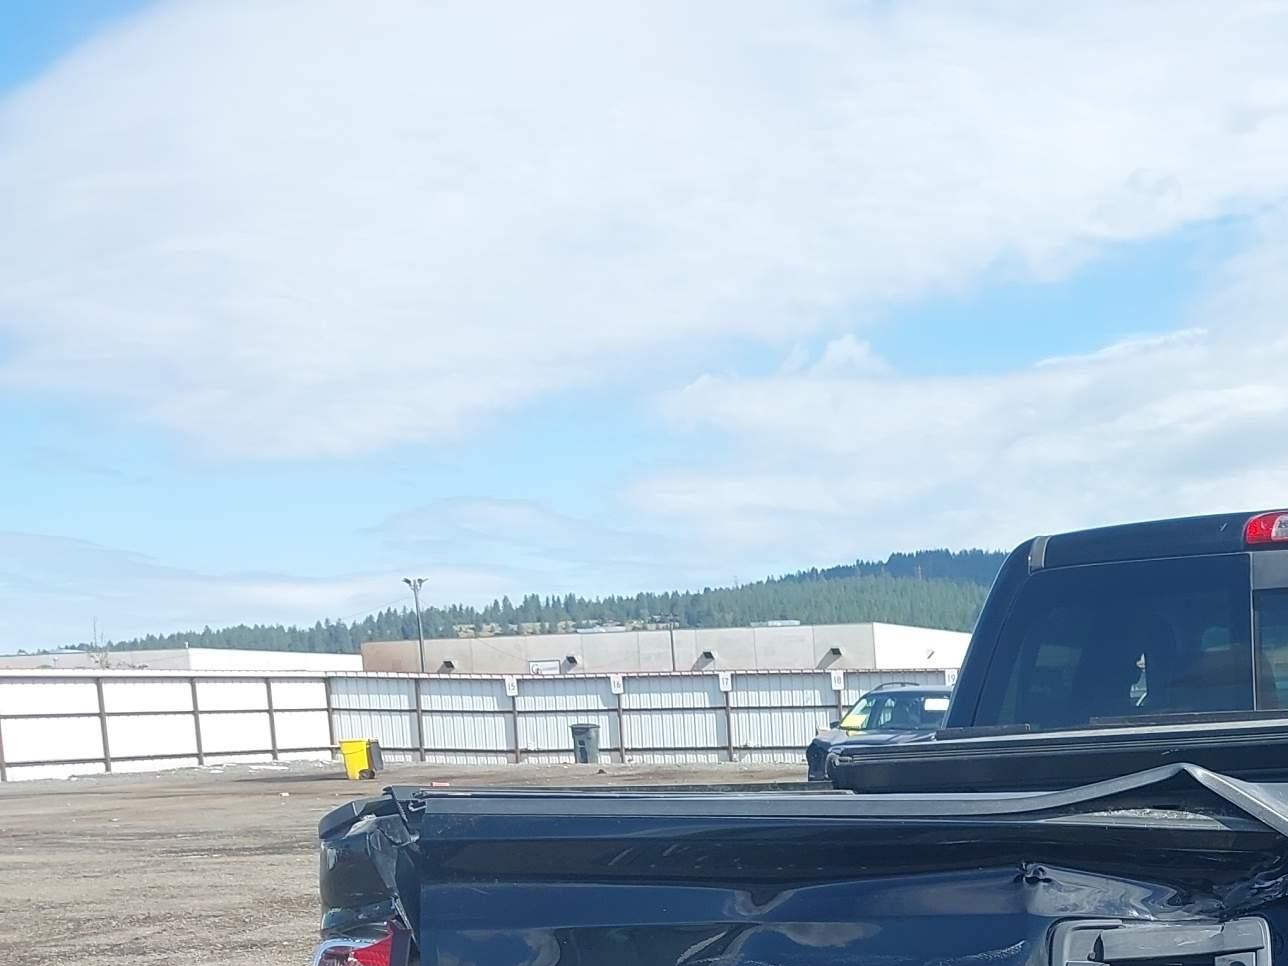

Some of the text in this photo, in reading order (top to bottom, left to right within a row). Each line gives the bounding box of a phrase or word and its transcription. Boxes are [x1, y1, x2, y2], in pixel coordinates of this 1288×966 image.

[721, 678, 729, 687] 17
[947, 674, 956, 683] 19
[507, 682, 516, 691] 15
